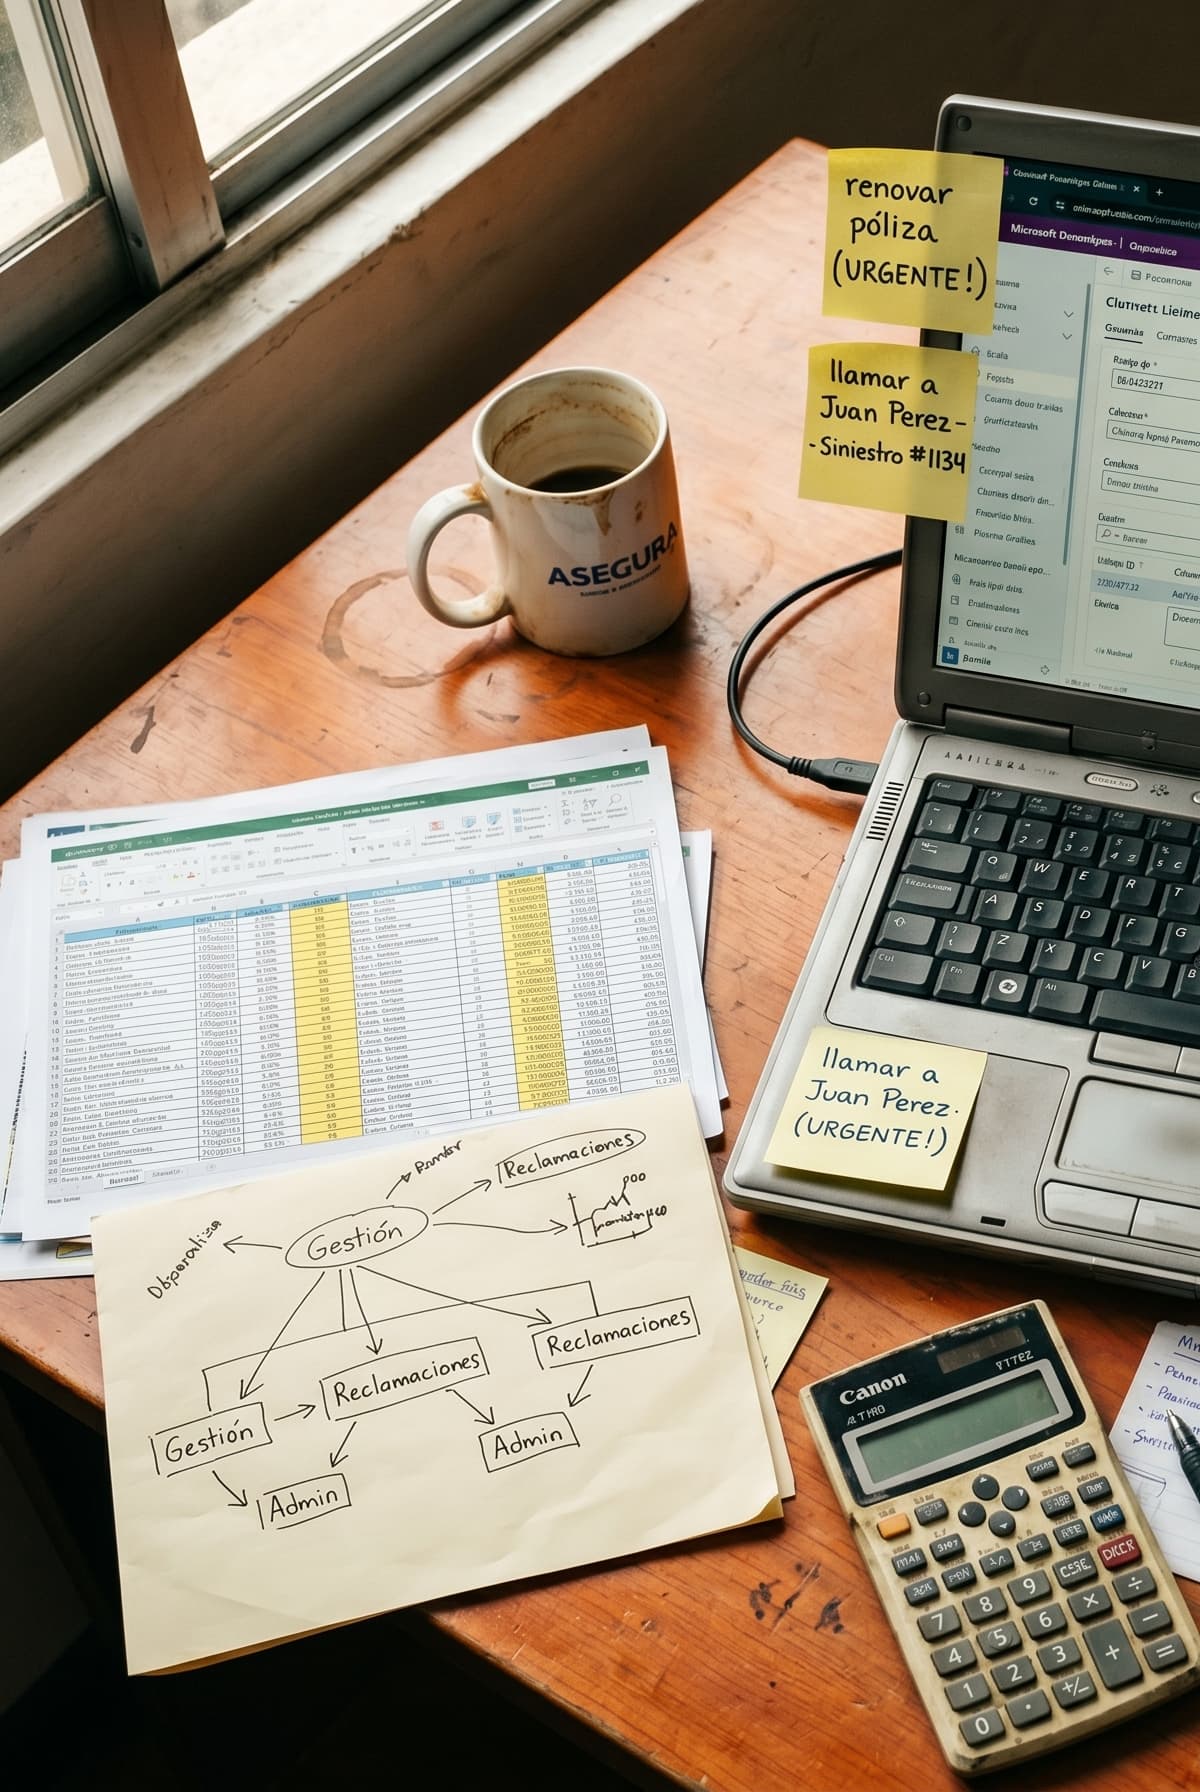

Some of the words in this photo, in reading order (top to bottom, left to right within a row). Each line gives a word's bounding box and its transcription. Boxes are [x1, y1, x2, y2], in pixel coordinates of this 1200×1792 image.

[845, 175, 953, 204] renovar
[850, 210, 938, 244] póliza
[1010, 223, 1056, 239] Microsoft
[832, 248, 988, 301] (URGENTE!)
[830, 358, 910, 391] llamar
[920, 378, 938, 395] a
[819, 395, 877, 424] Juan
[909, 446, 966, 473] #1134
[548, 521, 677, 586] ASEGURA
[987, 856, 998, 865] Q
[1034, 862, 1050, 873] W
[1079, 871, 1089, 880] E
[1126, 879, 1136, 889] R
[985, 895, 997, 904] A
[1174, 888, 1183, 897] T
[1033, 902, 1043, 912] S
[1080, 911, 1091, 919] D
[1126, 918, 1136, 928] F
[997, 935, 1009, 945] Z
[1175, 927, 1187, 938] G
[1045, 944, 1056, 953] X
[1094, 953, 1104, 962] C
[1142, 960, 1152, 970] V
[1187, 969, 1197, 978] B
[822, 1046, 910, 1078] llamar
[922, 1069, 939, 1084] a
[805, 1079, 869, 1105] Juan
[794, 1112, 947, 1157] (URGENTE!)
[504, 1132, 635, 1179] Reclamaciones
[307, 1220, 403, 1261] Gestión
[547, 1308, 691, 1356] Reclamaciones
[332, 1353, 481, 1406] Reclamaciones
[839, 1372, 908, 1405] Canon
[165, 1420, 254, 1463] Gestión
[493, 1426, 564, 1461] Admin
[268, 1487, 339, 1524] Admin
[1023, 1578, 1036, 1594] 9
[980, 1596, 993, 1613] 8
[930, 1613, 944, 1631] 7
[1038, 1611, 1052, 1627] 6
[994, 1628, 1007, 1646] 5
[948, 1648, 962, 1665] 4
[1052, 1645, 1067, 1662] 3
[1007, 1664, 1022, 1682] 2
[963, 1682, 973, 1698] 1
[975, 1717, 990, 1735] 0
